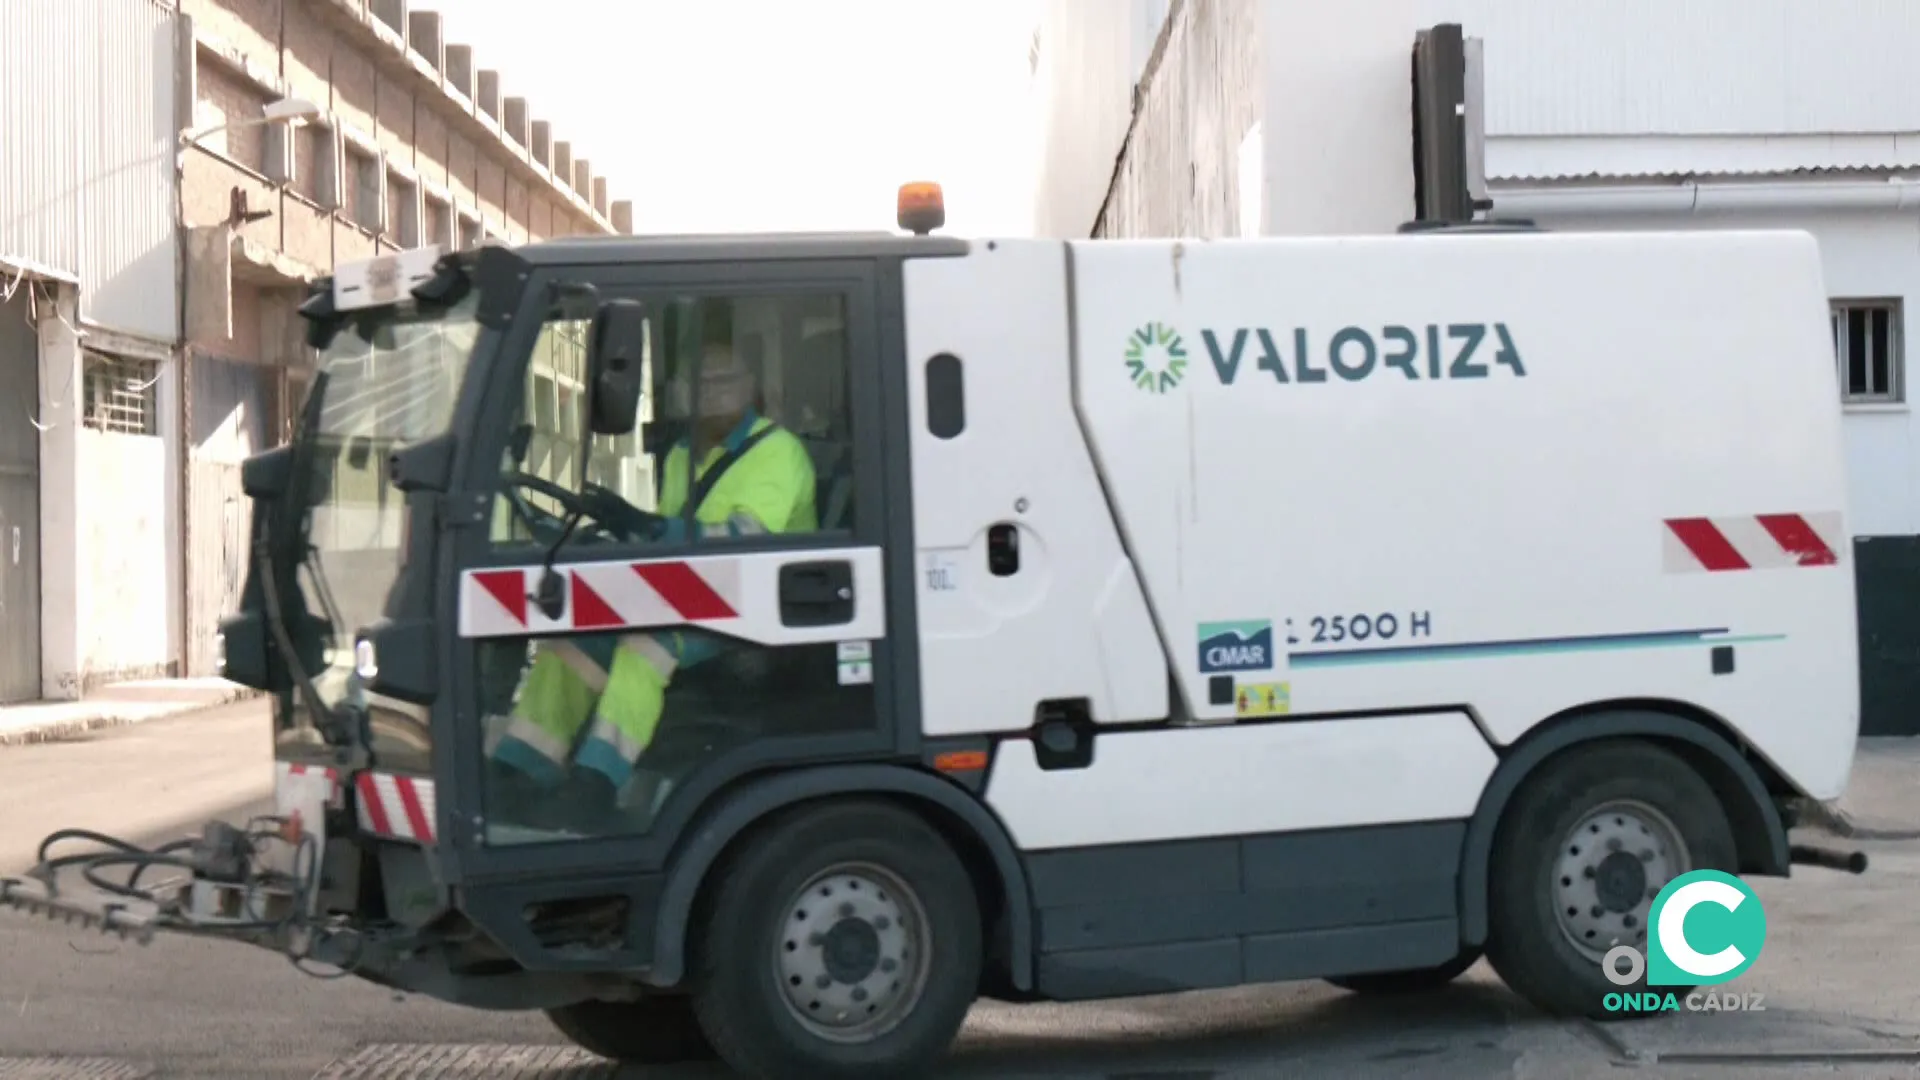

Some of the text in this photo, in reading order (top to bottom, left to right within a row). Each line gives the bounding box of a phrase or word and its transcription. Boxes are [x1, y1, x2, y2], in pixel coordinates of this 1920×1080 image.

[1201, 322, 1527, 385] VALORIZA
[1310, 612, 1398, 642] 2500
[1411, 610, 1431, 637] H
[1206, 645, 1265, 667] CMAR
